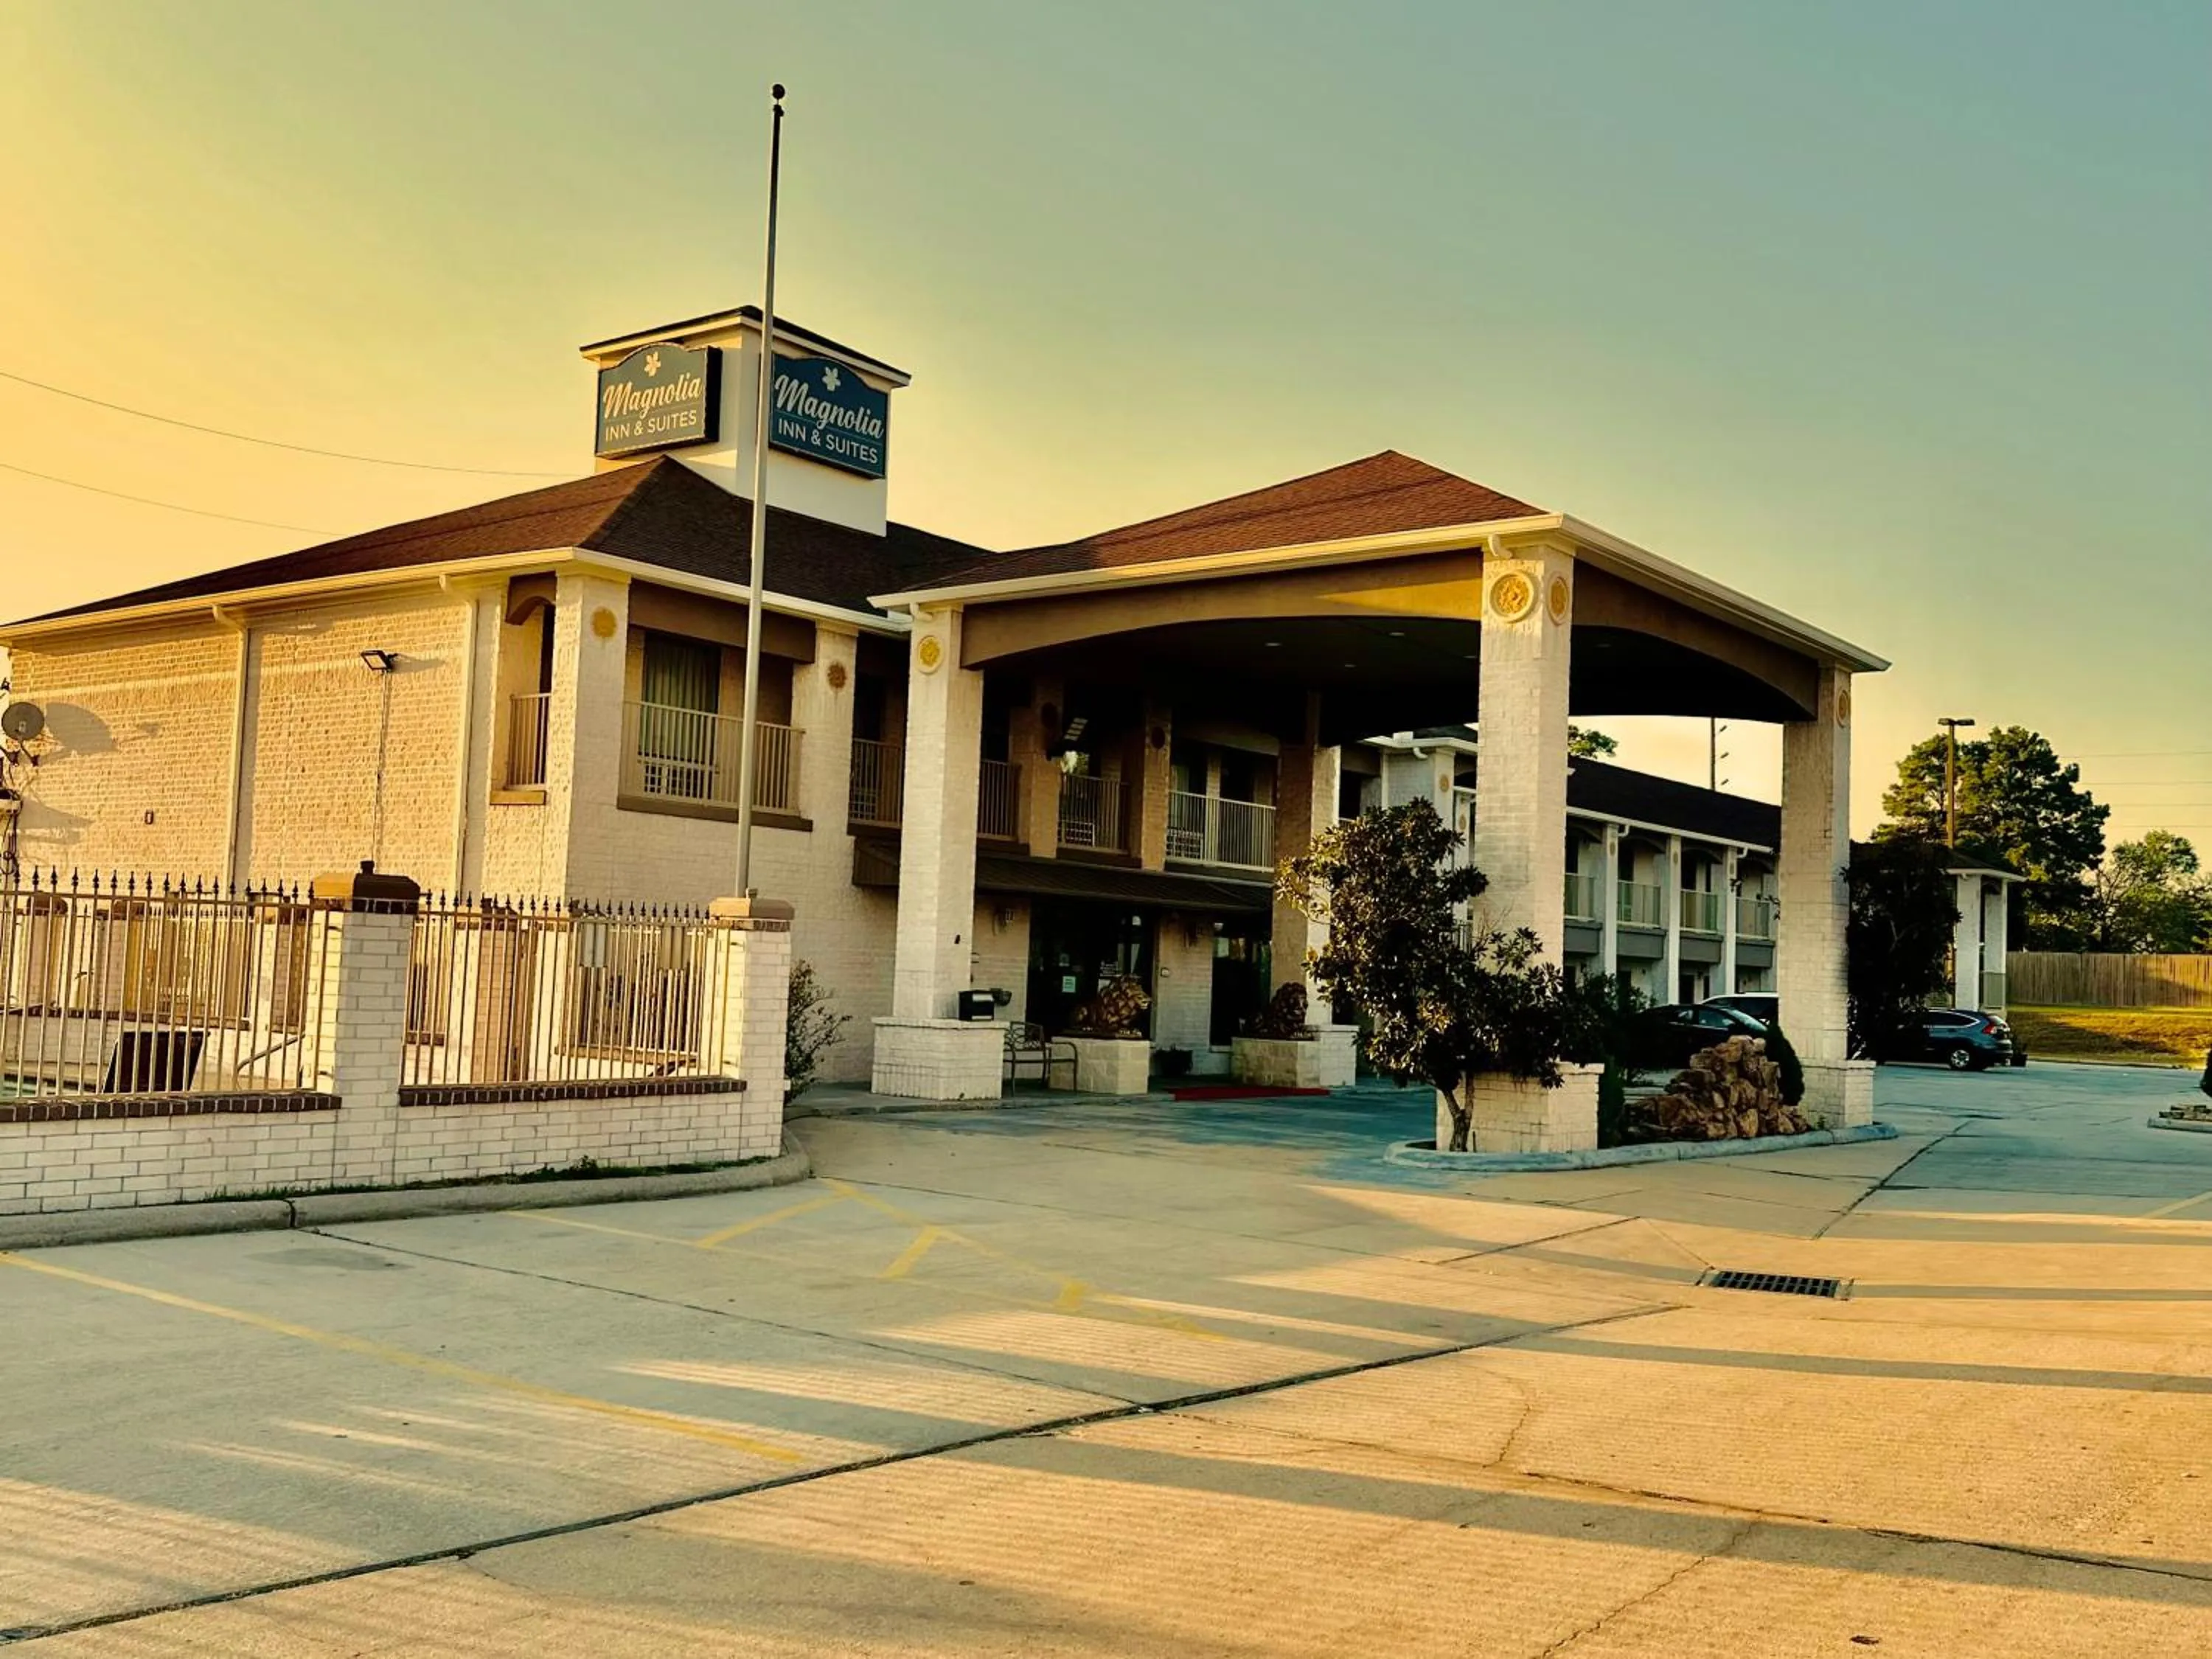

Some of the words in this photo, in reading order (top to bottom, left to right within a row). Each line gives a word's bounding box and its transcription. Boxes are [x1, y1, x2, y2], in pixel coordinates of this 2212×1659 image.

[603, 372, 701, 419] Magnolia
[775, 375, 884, 439] Magnolia
[605, 424, 630, 441] INN
[634, 421, 644, 436] &
[647, 410, 697, 434] SUITES
[779, 418, 806, 442] INN
[811, 429, 821, 446] &
[826, 434, 878, 464] SUITES
